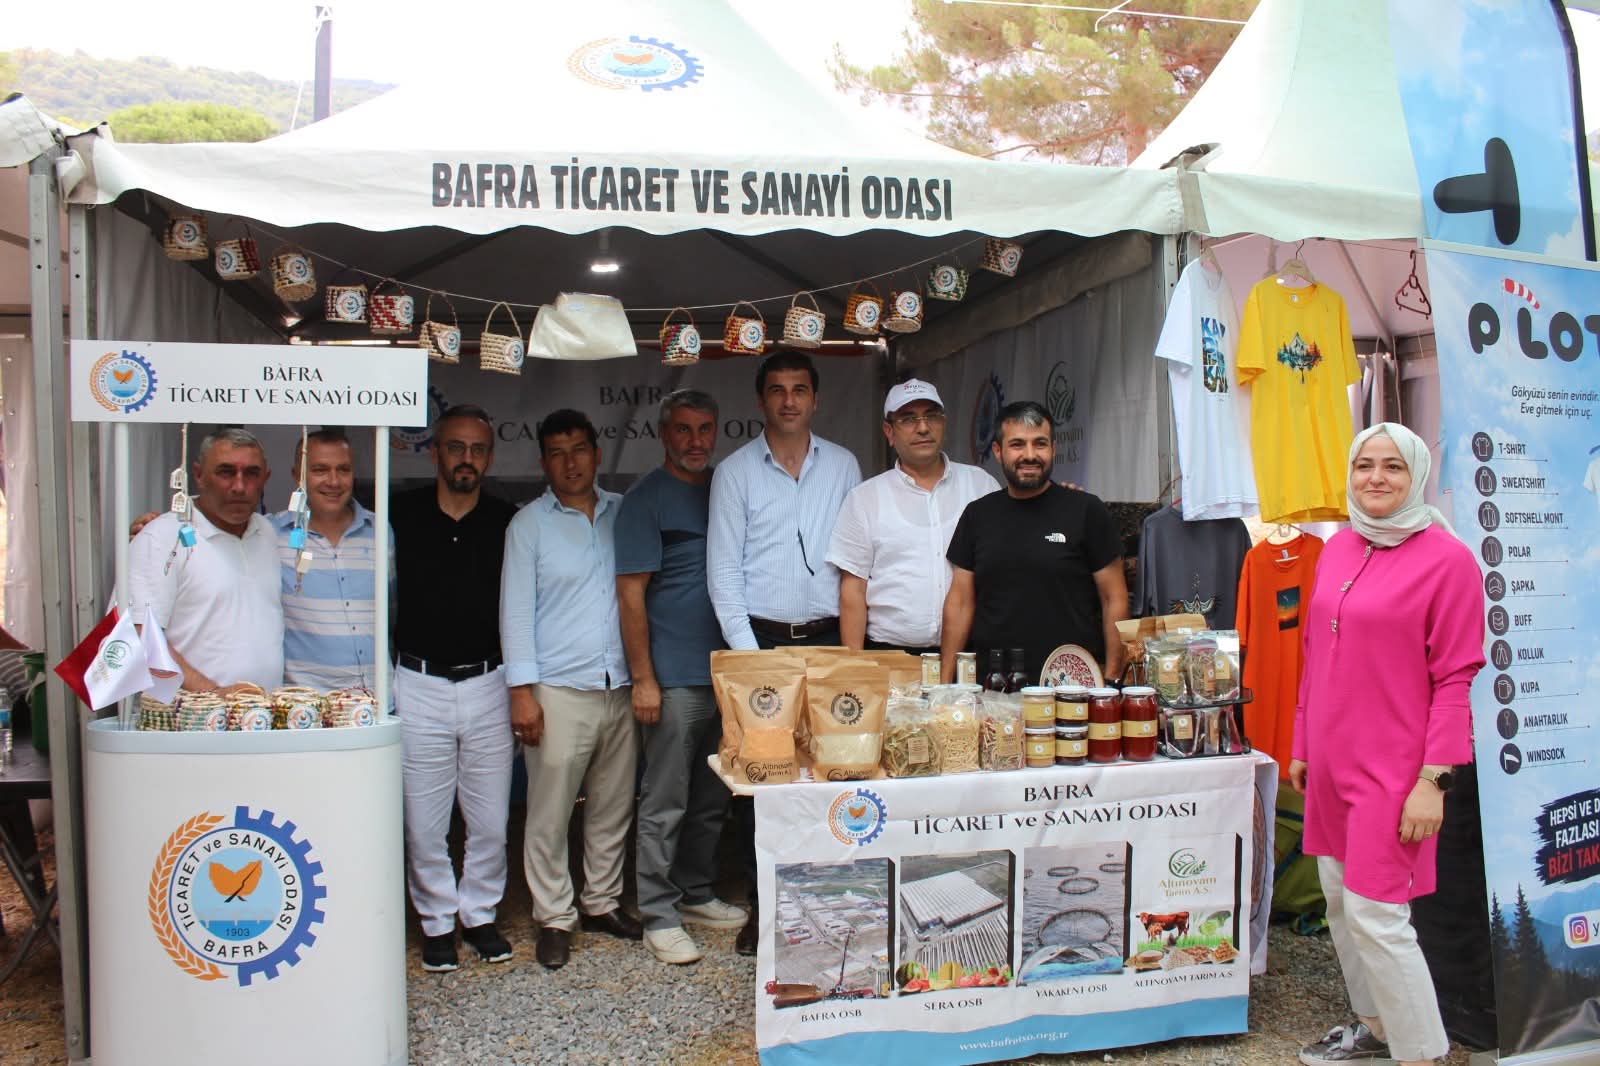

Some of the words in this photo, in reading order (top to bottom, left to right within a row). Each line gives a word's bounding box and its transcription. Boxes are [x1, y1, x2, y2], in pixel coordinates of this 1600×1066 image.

[432, 162, 541, 208] BAFRA
[551, 157, 679, 212] TİCARET
[691, 169, 730, 213] VE
[741, 166, 850, 218] SANAYİ
[861, 175, 952, 221] ODASI
[168, 383, 250, 404] TİCARET
[256, 388, 279, 404] VE
[284, 385, 351, 405] SANAYİ
[357, 390, 417, 406] ODASI
[1511, 385, 1546, 400] Gökyüzü
[1547, 388, 1569, 400] senin
[1520, 402, 1534, 414] Eve
[1536, 404, 1563, 417] gitmek
[1564, 406, 1580, 419] için
[1581, 408, 1593, 419] uç.
[1498, 443, 1526, 455] T-SHIRT
[1502, 477, 1546, 489] SWEATSHIRT
[1505, 512, 1543, 524] SOFTSHELL
[1544, 512, 1564, 524] MONT
[1508, 546, 1531, 557] POLAR
[1511, 580, 1535, 595] ŞAPKA
[1514, 615, 1532, 627] BUFF
[1517, 647, 1544, 661] KOLLUK
[1520, 681, 1540, 694] KUPA
[1523, 713, 1568, 729] ANAHTARLIK
[1526, 748, 1566, 763] WINDSOCK
[1024, 783, 1094, 802] BAFRA
[913, 813, 1008, 835] TİCARET
[1014, 816, 1038, 829] ve
[1044, 802, 1122, 827] SANAYİ
[1128, 802, 1198, 821] ODASI
[1550, 800, 1577, 827] HEPSİ
[1579, 799, 1592, 818] VE
[1555, 819, 1599, 848] FAZLASI
[1548, 851, 1573, 879] BİZİ
[203, 839, 221, 853] ve
[276, 874, 297, 931] ODASI
[225, 927, 250, 937] 1903
[203, 939, 269, 959] BAFRA
[1189, 972, 1217, 982] TARIM
[1036, 986, 1085, 999] YAKAKENT
[1087, 984, 1108, 994] OSB
[923, 1001, 955, 1012] SERA
[957, 997, 983, 1009] OSB
[801, 1012, 836, 1023] BAFRA
[838, 1009, 862, 1019] OSB
